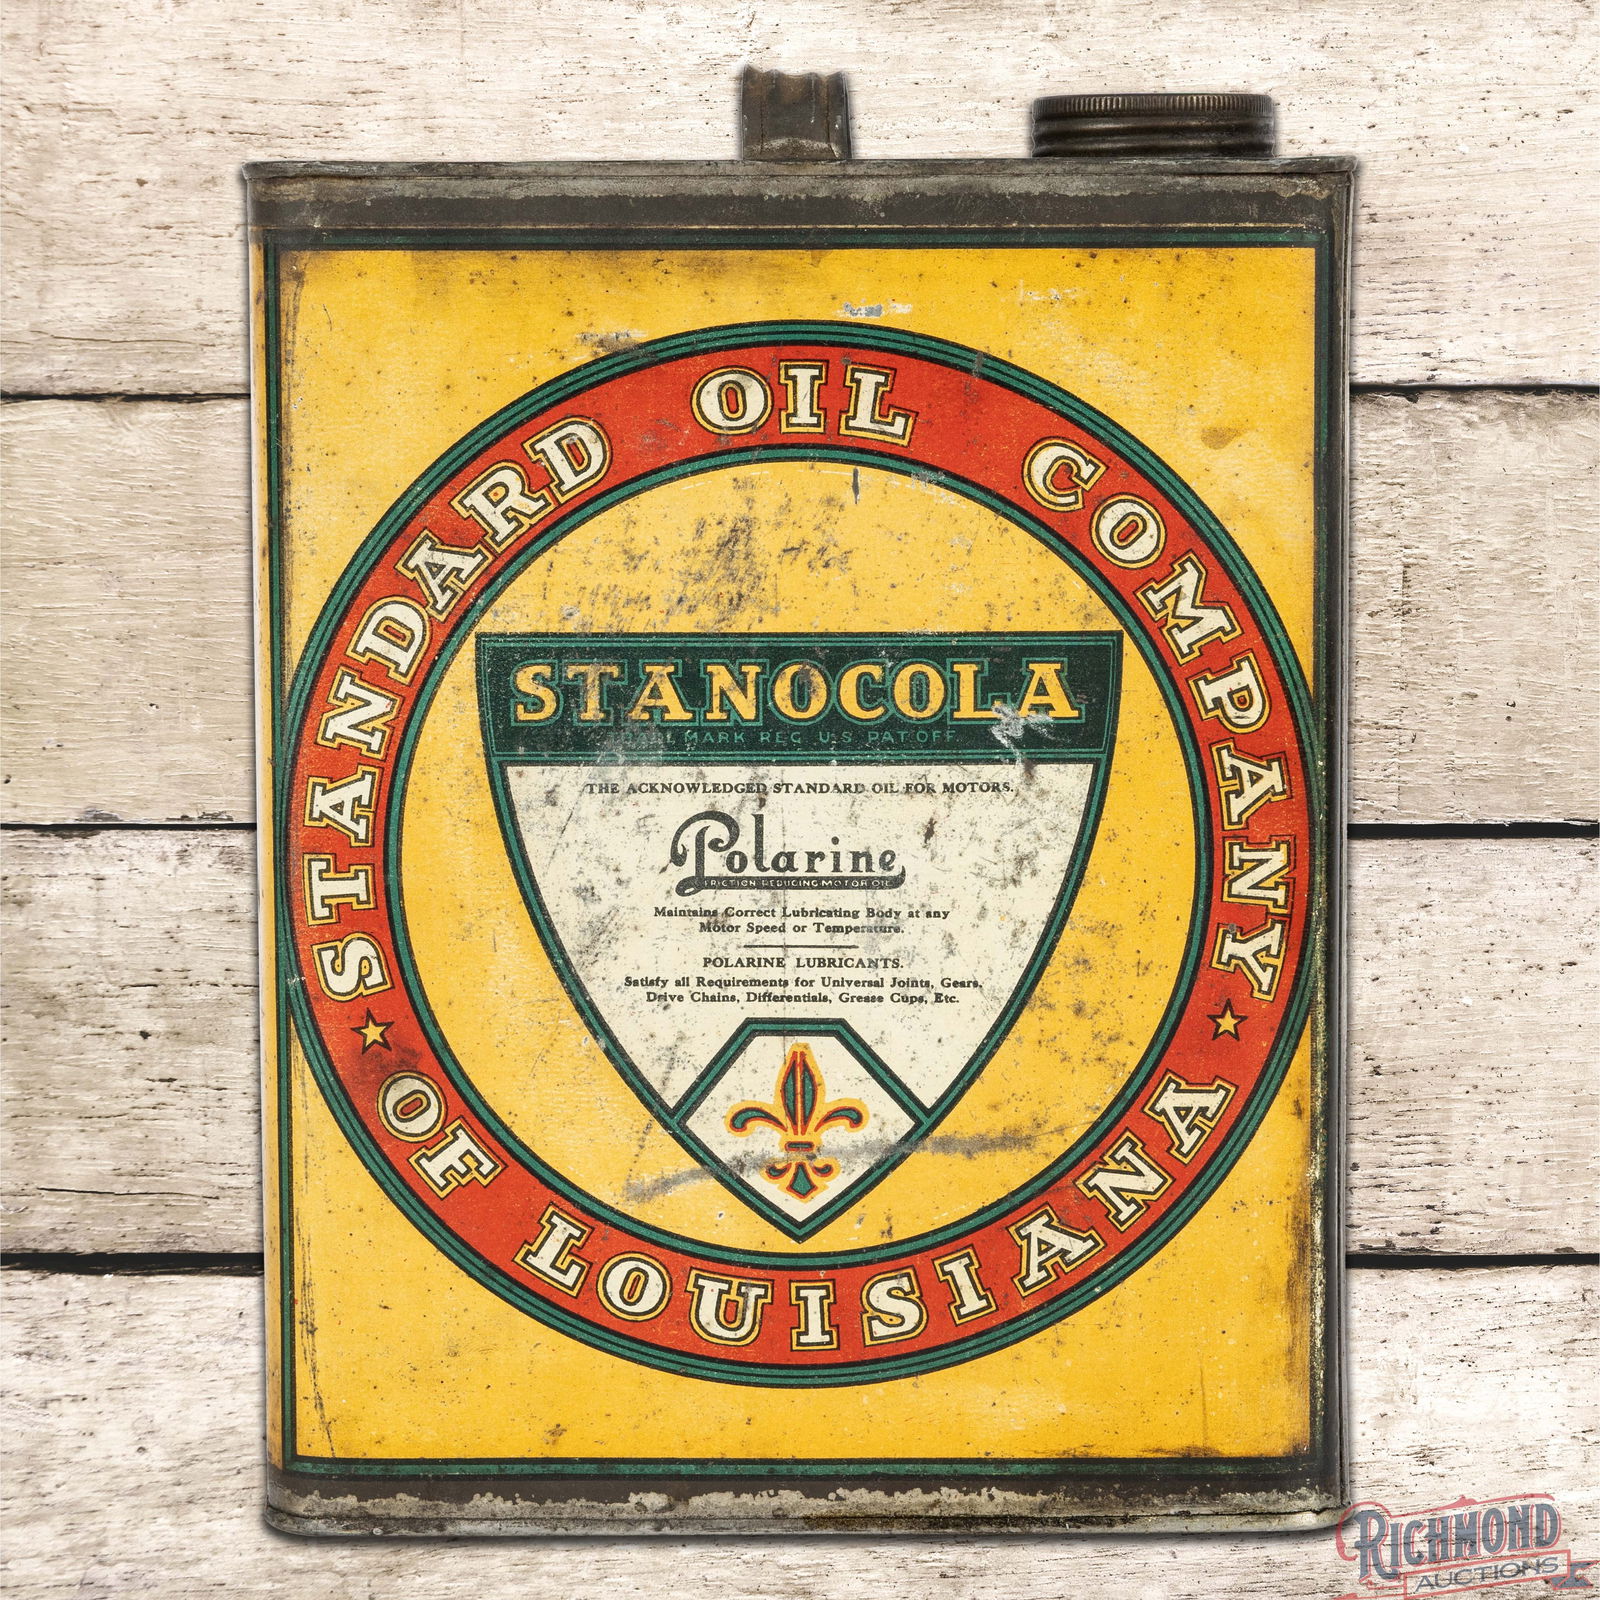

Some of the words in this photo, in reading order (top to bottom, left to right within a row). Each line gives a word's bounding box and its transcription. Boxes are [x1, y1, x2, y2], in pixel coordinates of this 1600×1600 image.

[303, 415, 613, 1002] STANDARD
[691, 360, 916, 447] OIL
[1022, 437, 1296, 1002] COMPANY
[510, 658, 1086, 726] STANOCOLA
[684, 730, 745, 744] MARK
[588, 782, 620, 794] THE
[626, 782, 768, 794] ACKNOWLEDGED
[772, 782, 866, 794] STANDARD
[871, 782, 900, 794] OIL
[905, 782, 936, 794] FOR
[941, 782, 1014, 794] MOTORS.
[670, 810, 902, 897] Polarine
[654, 906, 719, 918] Maintains
[724, 906, 776, 918] Correct
[781, 907, 861, 920] Lubricating
[866, 907, 902, 920] Body
[907, 909, 921, 919] at
[925, 910, 951, 920] any
[699, 921, 741, 933] Motor
[746, 921, 786, 935] Speed
[792, 924, 808, 933] or
[812, 922, 905, 935] Temperature.
[702, 957, 786, 968] POLARINE
[796, 957, 905, 969] LUBRICANTS.
[624, 976, 670, 989] Satisfy
[674, 976, 690, 988] all
[696, 976, 789, 989] Requirements
[794, 976, 816, 988] for
[821, 976, 885, 988] Universal
[890, 976, 935, 989] Joints,
[646, 991, 685, 1003] Drive
[690, 991, 741, 1004] Chains,
[746, 991, 833, 1004] Differentials,
[838, 992, 885, 1004] Grease
[890, 992, 928, 1005] Cups,
[933, 992, 960, 1004] Etc.
[377, 1070, 507, 1201] OF
[513, 1068, 1238, 1352] LOUISIANA
